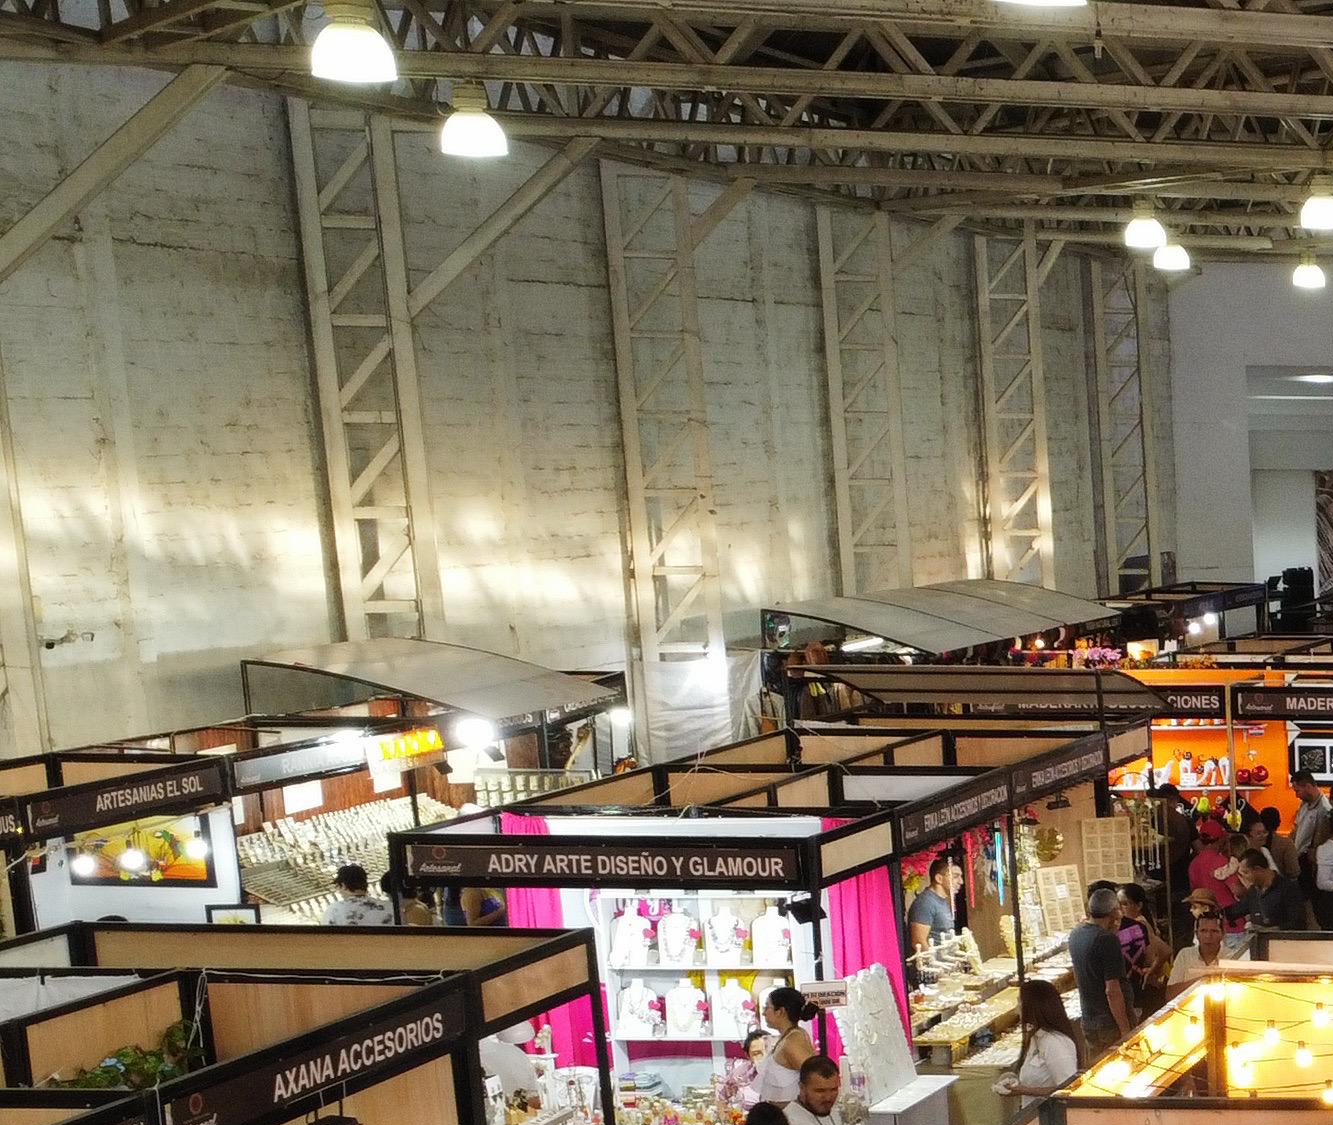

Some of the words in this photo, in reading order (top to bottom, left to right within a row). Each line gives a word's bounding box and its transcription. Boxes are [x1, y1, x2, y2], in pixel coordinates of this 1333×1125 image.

[96, 780, 165, 813] ARTESANIAS
[166, 778, 181, 797] EL
[181, 775, 204, 792] SOL
[488, 853, 538, 874] ADRY
[543, 855, 592, 875] ARTE
[598, 851, 670, 876] DISEÑO
[672, 856, 684, 876] Y
[690, 856, 785, 877] GLAMOUR
[273, 1057, 334, 1103] AXANA
[338, 1013, 444, 1076] ACCESORIOS
